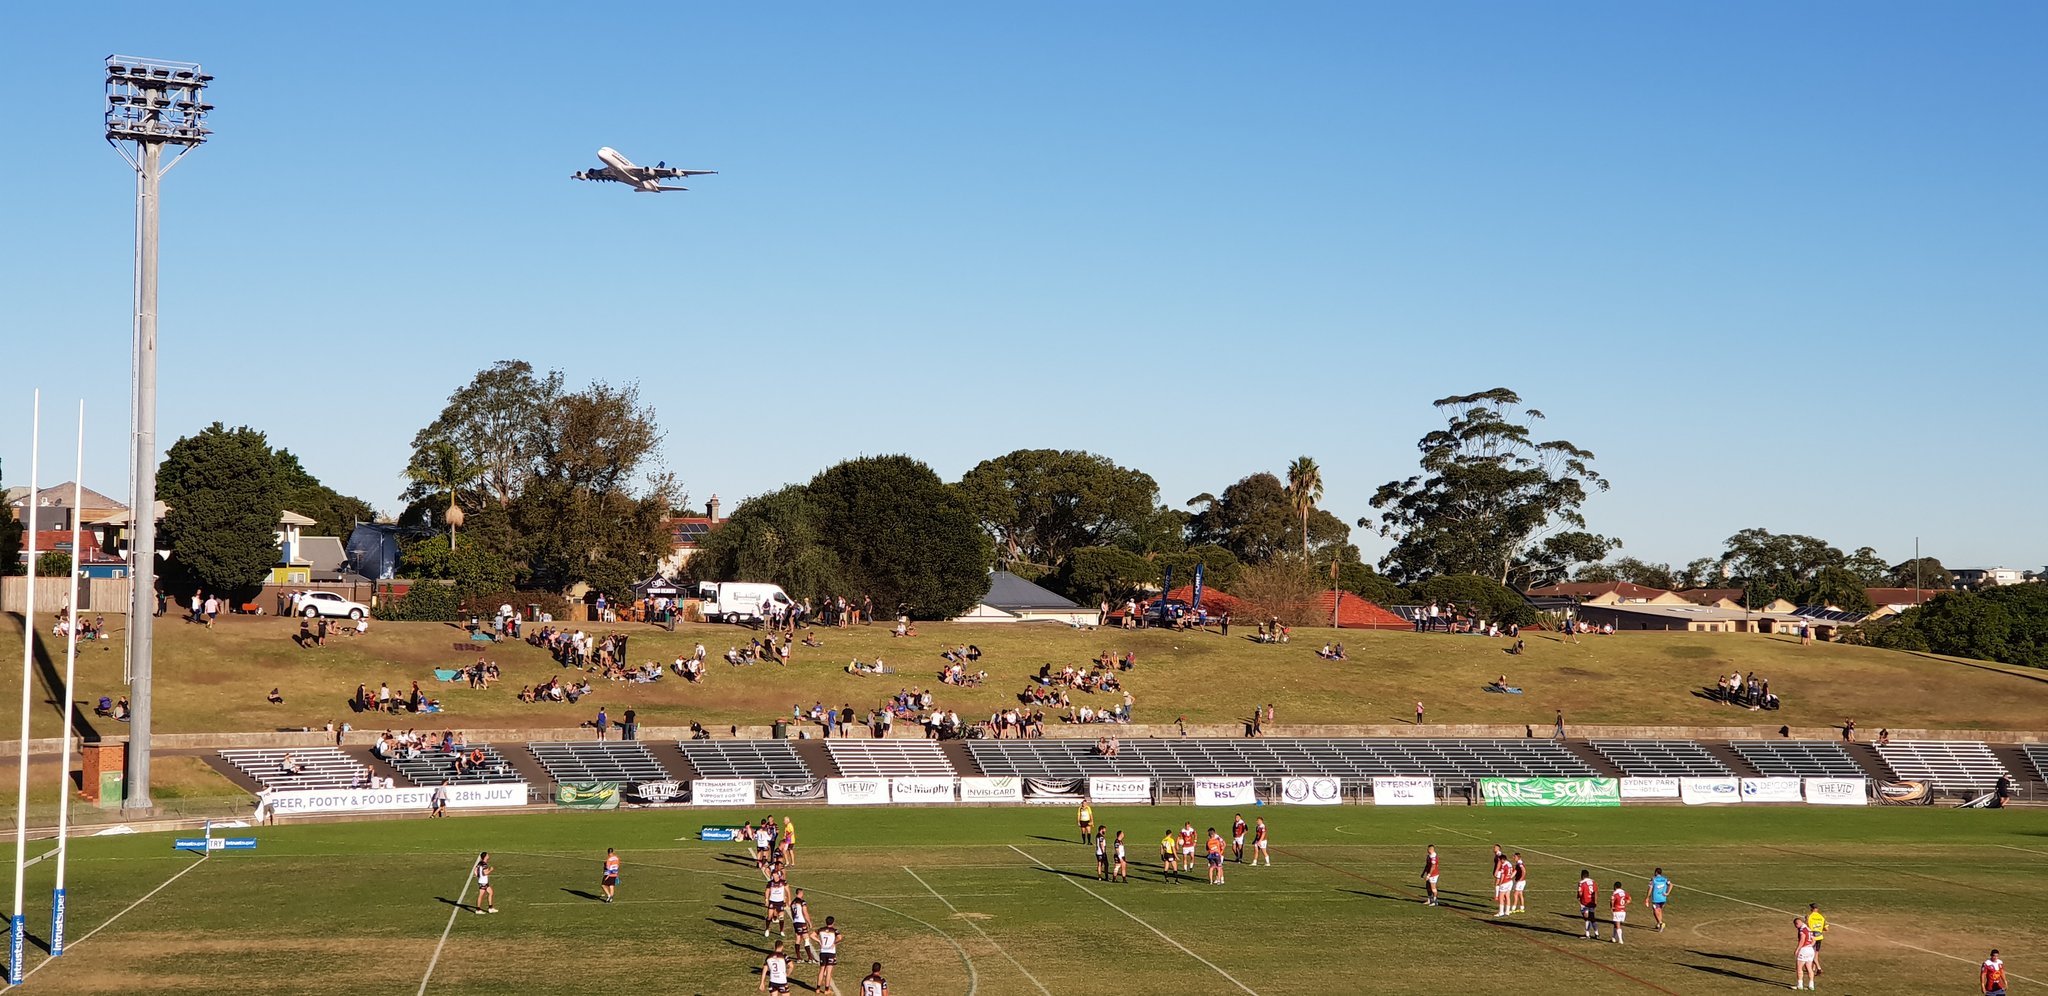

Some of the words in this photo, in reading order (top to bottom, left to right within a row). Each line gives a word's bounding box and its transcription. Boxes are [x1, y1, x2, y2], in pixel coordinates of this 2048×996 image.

[841, 783, 859, 793] THE
[859, 782, 875, 793] VIC
[1096, 783, 1145, 792] HENSON
[1196, 780, 1252, 789] PETERSHAM
[1375, 780, 1432, 788] PETERSHAM
[1819, 784, 1836, 793] THE
[1836, 784, 1852, 793] VIC
[640, 785, 661, 797] THE
[661, 785, 677, 796] VIC
[914, 783, 949, 795] Murphy
[272, 798, 306, 808] BEER,
[309, 796, 348, 807] FOOTY
[351, 796, 358, 806] &
[362, 794, 393, 805] FOOD
[455, 791, 481, 801] 28th
[485, 789, 513, 800] JULY
[1214, 791, 1235, 799] RSL
[1393, 790, 1414, 798] RSL
[823, 936, 829, 946] 7
[772, 962, 778, 972] 3
